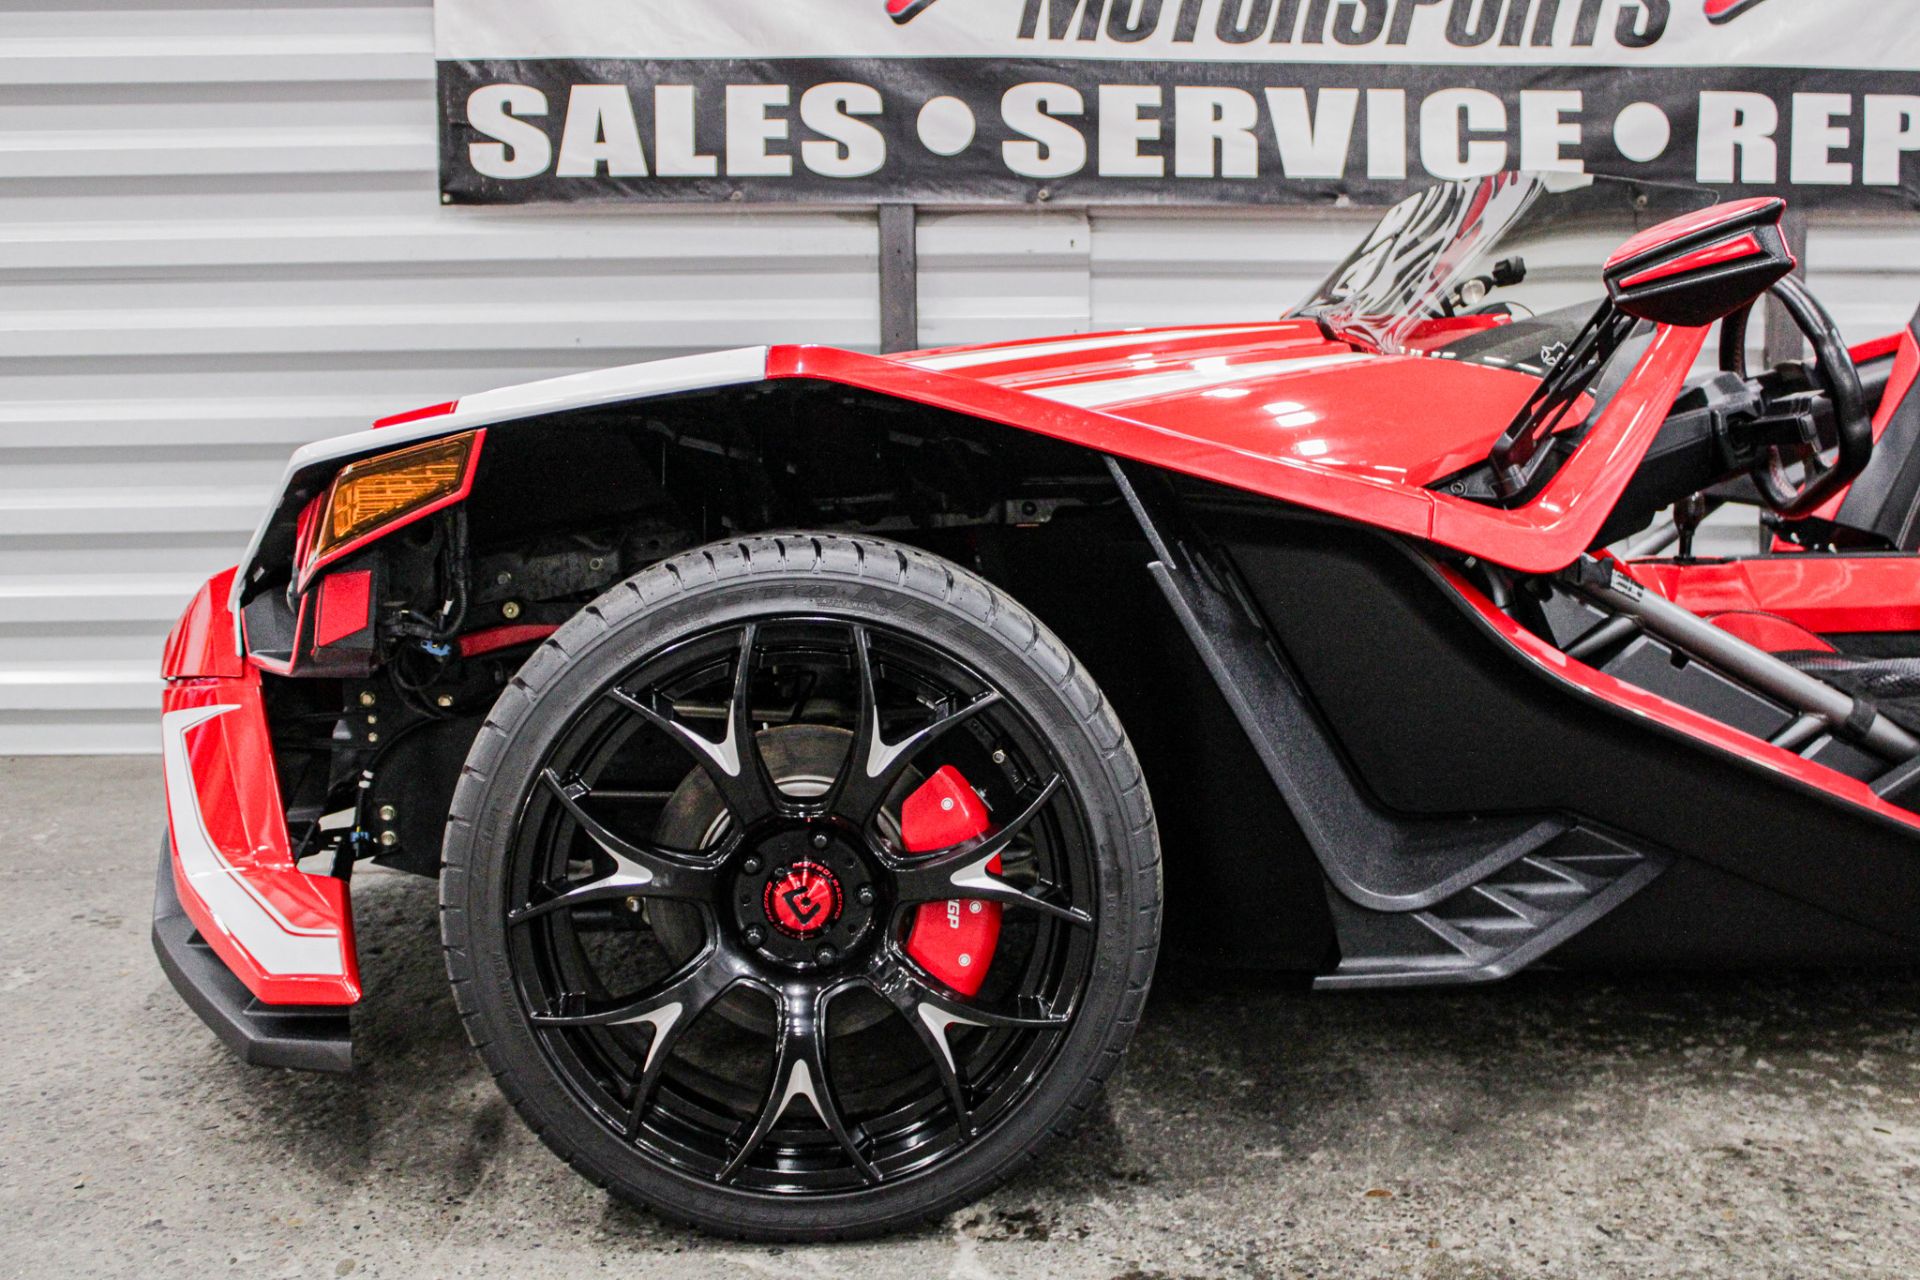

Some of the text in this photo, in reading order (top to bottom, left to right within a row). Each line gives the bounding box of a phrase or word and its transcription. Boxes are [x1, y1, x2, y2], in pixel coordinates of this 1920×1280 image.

[466, 82, 1920, 186] SALES SERVICE REP
[947, 898, 960, 929] GP
